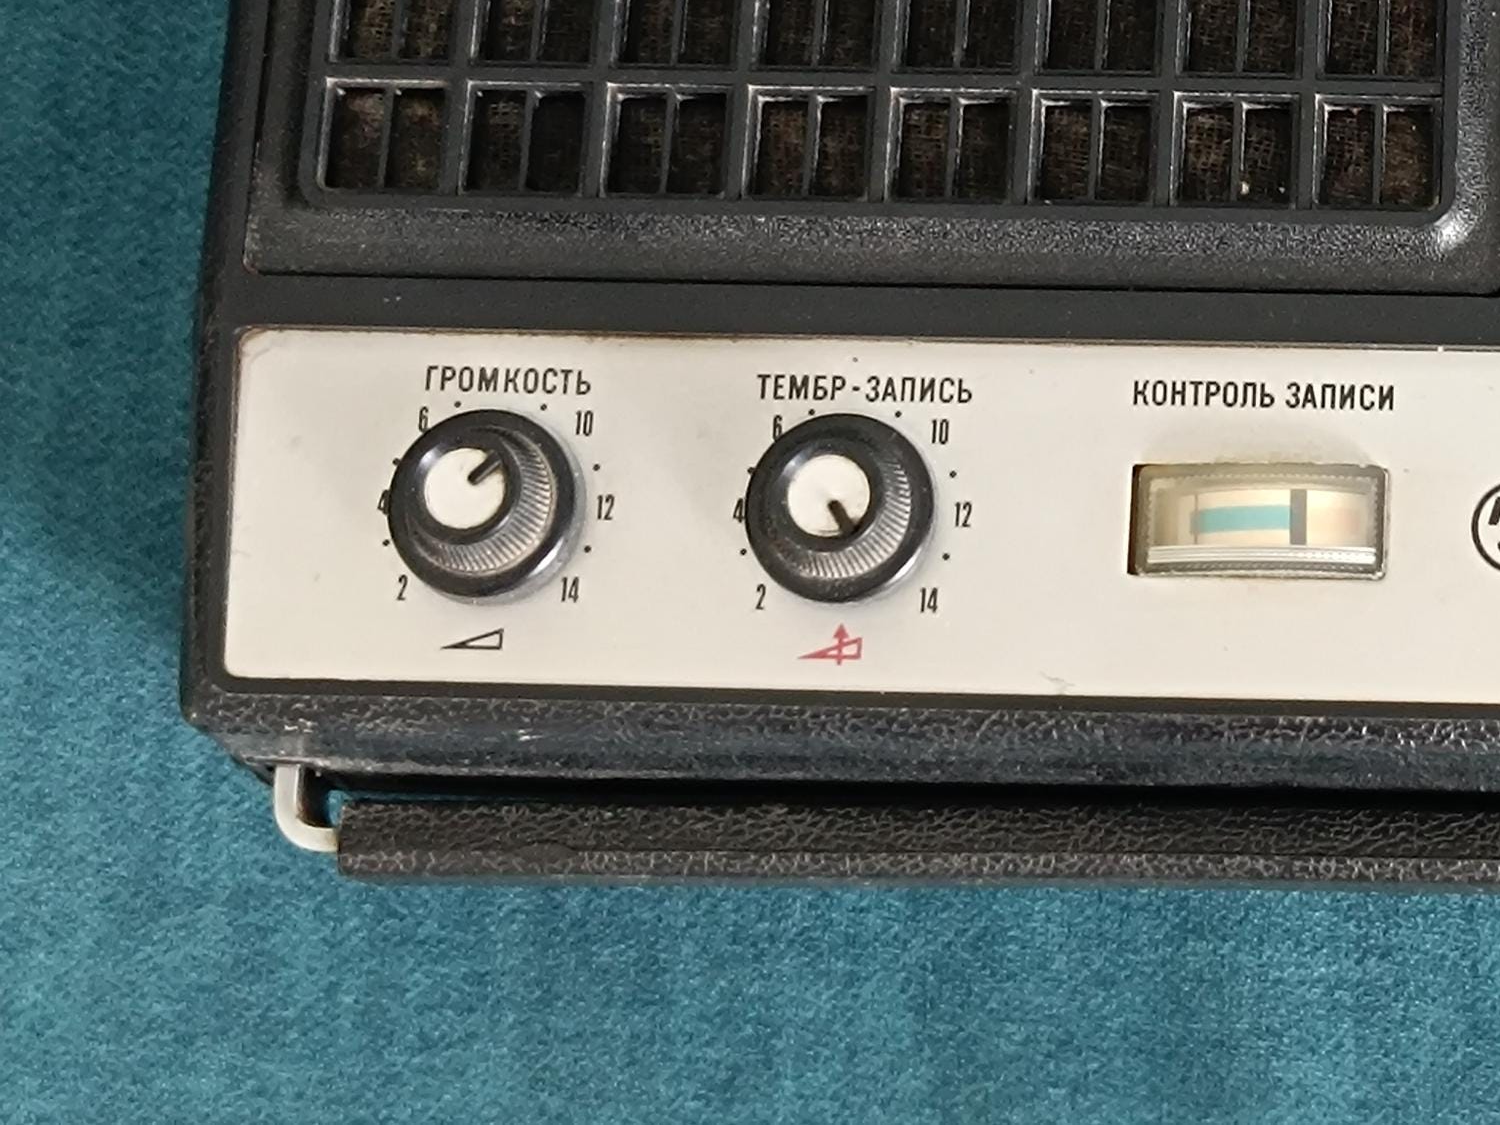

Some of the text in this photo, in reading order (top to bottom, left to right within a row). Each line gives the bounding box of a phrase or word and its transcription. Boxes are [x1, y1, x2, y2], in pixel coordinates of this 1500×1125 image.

[424, 365, 592, 395] ГРОМКОСТЬ
[1132, 380, 1395, 412] КОНТРОЛЬ ЗАПИСИ
[418, 406, 428, 433] 6
[575, 410, 594, 437] 10
[772, 415, 783, 441] 6
[931, 418, 949, 445] 10
[377, 489, 389, 515] 4
[597, 494, 615, 521] 12
[733, 498, 746, 524] 4
[955, 501, 973, 528] 12
[396, 575, 408, 601] 2
[561, 577, 579, 603] 14
[756, 584, 766, 610] 2
[920, 588, 938, 614] 14
